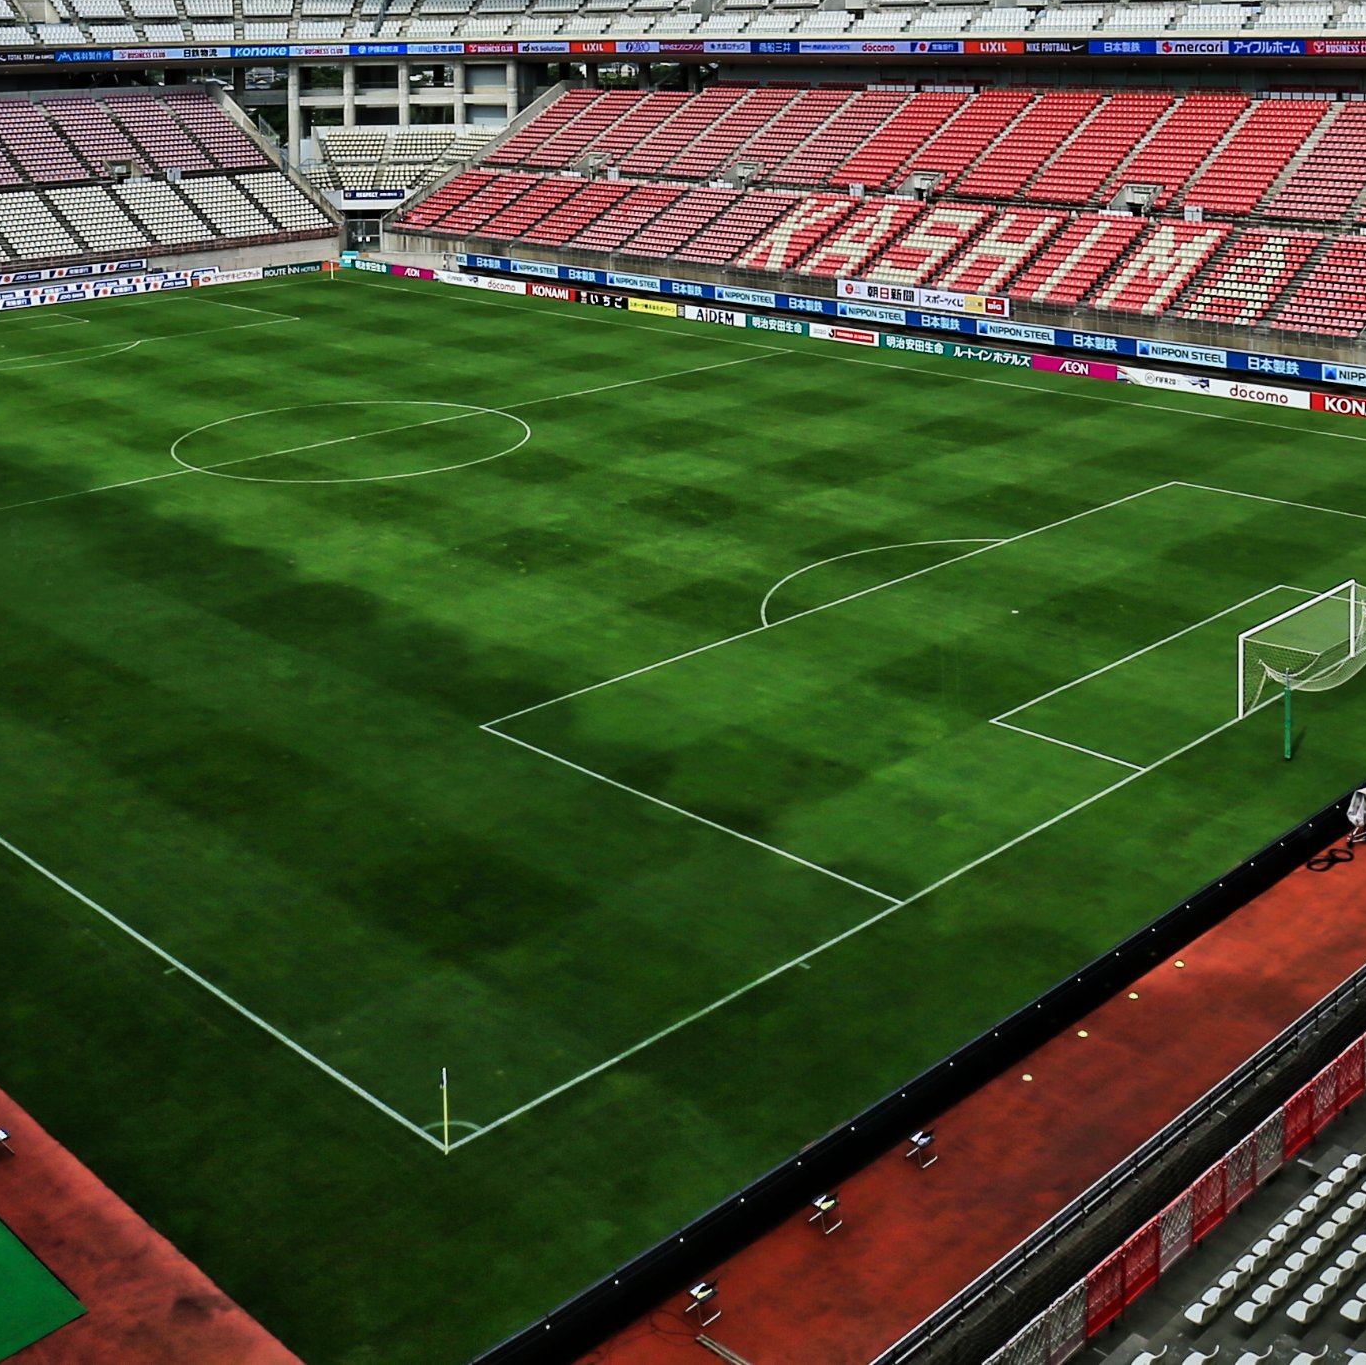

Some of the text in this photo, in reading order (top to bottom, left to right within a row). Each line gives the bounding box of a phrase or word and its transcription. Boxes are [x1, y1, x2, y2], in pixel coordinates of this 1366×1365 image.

[582, 44, 603, 52] LIXIL
[862, 43, 895, 52] docomo
[980, 42, 1007, 52] LIXIL
[1026, 43, 1071, 52] NIKE FOOTBALL
[1175, 42, 1224, 53] mercari
[1233, 42, 1301, 54] アイフルホーム
[1325, 44, 1359, 53] BUSINESS
[264, 268, 286, 278] ROUTE
[519, 264, 557, 275] NIPPON STEEL
[487, 279, 515, 292] docomo
[616, 276, 658, 288] NIPPON STEEL
[532, 286, 569, 300] KONAMI
[725, 291, 773, 305] NIPPON STEEL
[867, 286, 914, 302] 朝日新聞
[590, 293, 622, 308] いちご
[789, 298, 823, 312] 日本製鉄
[925, 295, 964, 308] スポーツくじ
[848, 308, 904, 322] NIPPON STEEL
[752, 316, 803, 333] 明治安田生命
[921, 315, 960, 331] 日本製鉄
[989, 327, 1053, 341] NIPPON STEEL
[886, 336, 943, 354] 明治安田生命
[1072, 334, 1117, 352] 日本製鉄
[1151, 346, 1224, 364] NIPPON STEEL
[1247, 356, 1299, 376] 日本製鉄
[1230, 384, 1288, 404] docomo
